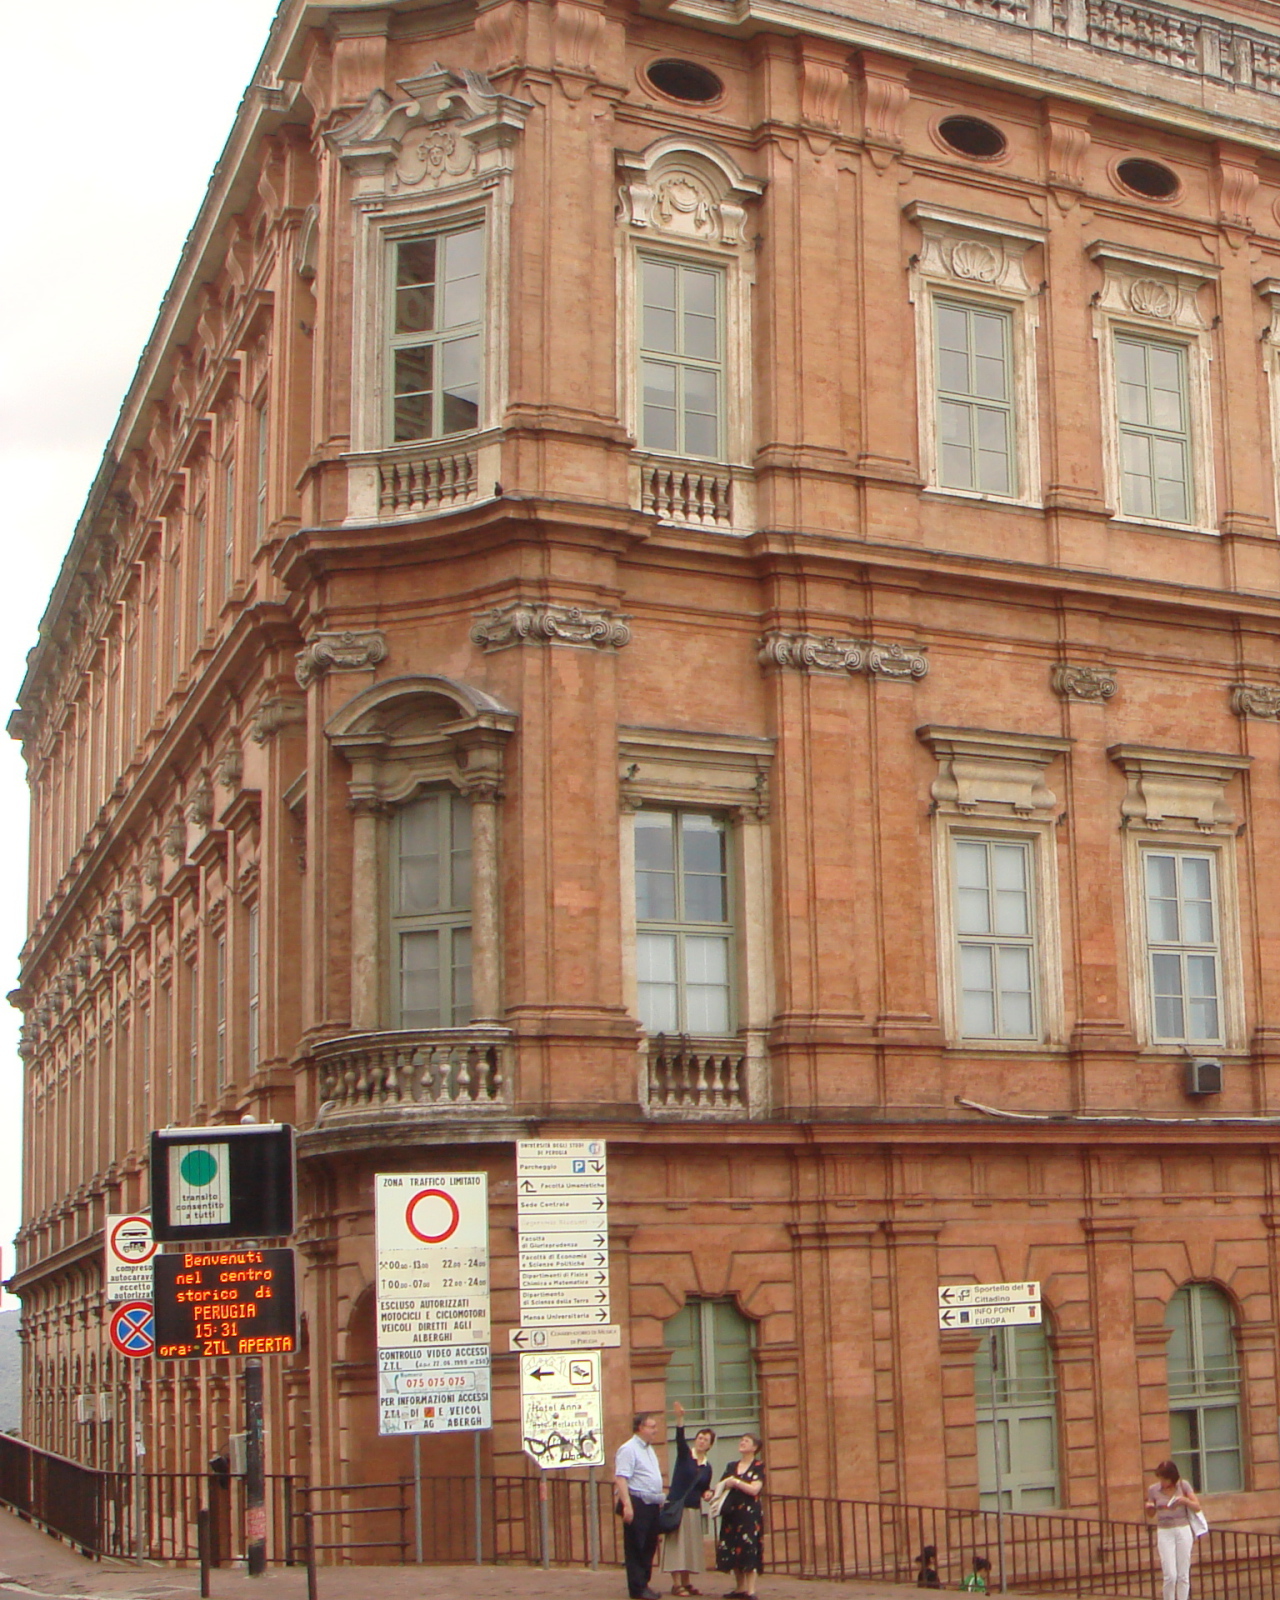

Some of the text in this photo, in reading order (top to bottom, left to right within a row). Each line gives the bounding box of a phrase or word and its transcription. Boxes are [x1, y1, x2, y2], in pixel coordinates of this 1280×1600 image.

[383, 1176, 481, 1187] ZONA TRAFFICO LIMITATO
[182, 1193, 218, 1201] transito
[176, 1202, 224, 1211] consentito
[194, 1210, 215, 1219] tutti
[184, 1251, 263, 1268] Benvenuti
[116, 1265, 154, 1274] compreso
[176, 1269, 273, 1285] nel centro
[120, 1283, 150, 1291] eccetto
[974, 1285, 1010, 1294] Sportello
[176, 1285, 272, 1303] storico di
[381, 1299, 469, 1310] ESCLUSO AUTORIZZATI
[194, 1303, 256, 1321] PERUGIA
[381, 1309, 486, 1322] MOTOCICLI E CICLOMOTORI
[974, 1306, 1015, 1315] INFO POINT
[975, 1317, 1006, 1325] EUROPA
[195, 1323, 238, 1338] 15:31
[381, 1321, 472, 1333] VEICOLI DIRETTI AGLI
[413, 1333, 452, 1342] ALBERGHI
[160, 1337, 292, 1357] ora: ZTL APERTA
[380, 1347, 487, 1360] CONTROLLO VIDEO ACCESSI
[383, 1362, 402, 1370] Z.T.L.
[406, 1377, 466, 1388] 075 075 075
[380, 1393, 489, 1406] PER INFORMAZIONI ACCESSI
[410, 1408, 419, 1417] DI
[439, 1407, 443, 1416] E
[449, 1405, 481, 1415] VEICOL
[560, 1403, 582, 1411] Anna
[424, 1420, 434, 1429] AG
[447, 1417, 482, 1427] ABERGH
